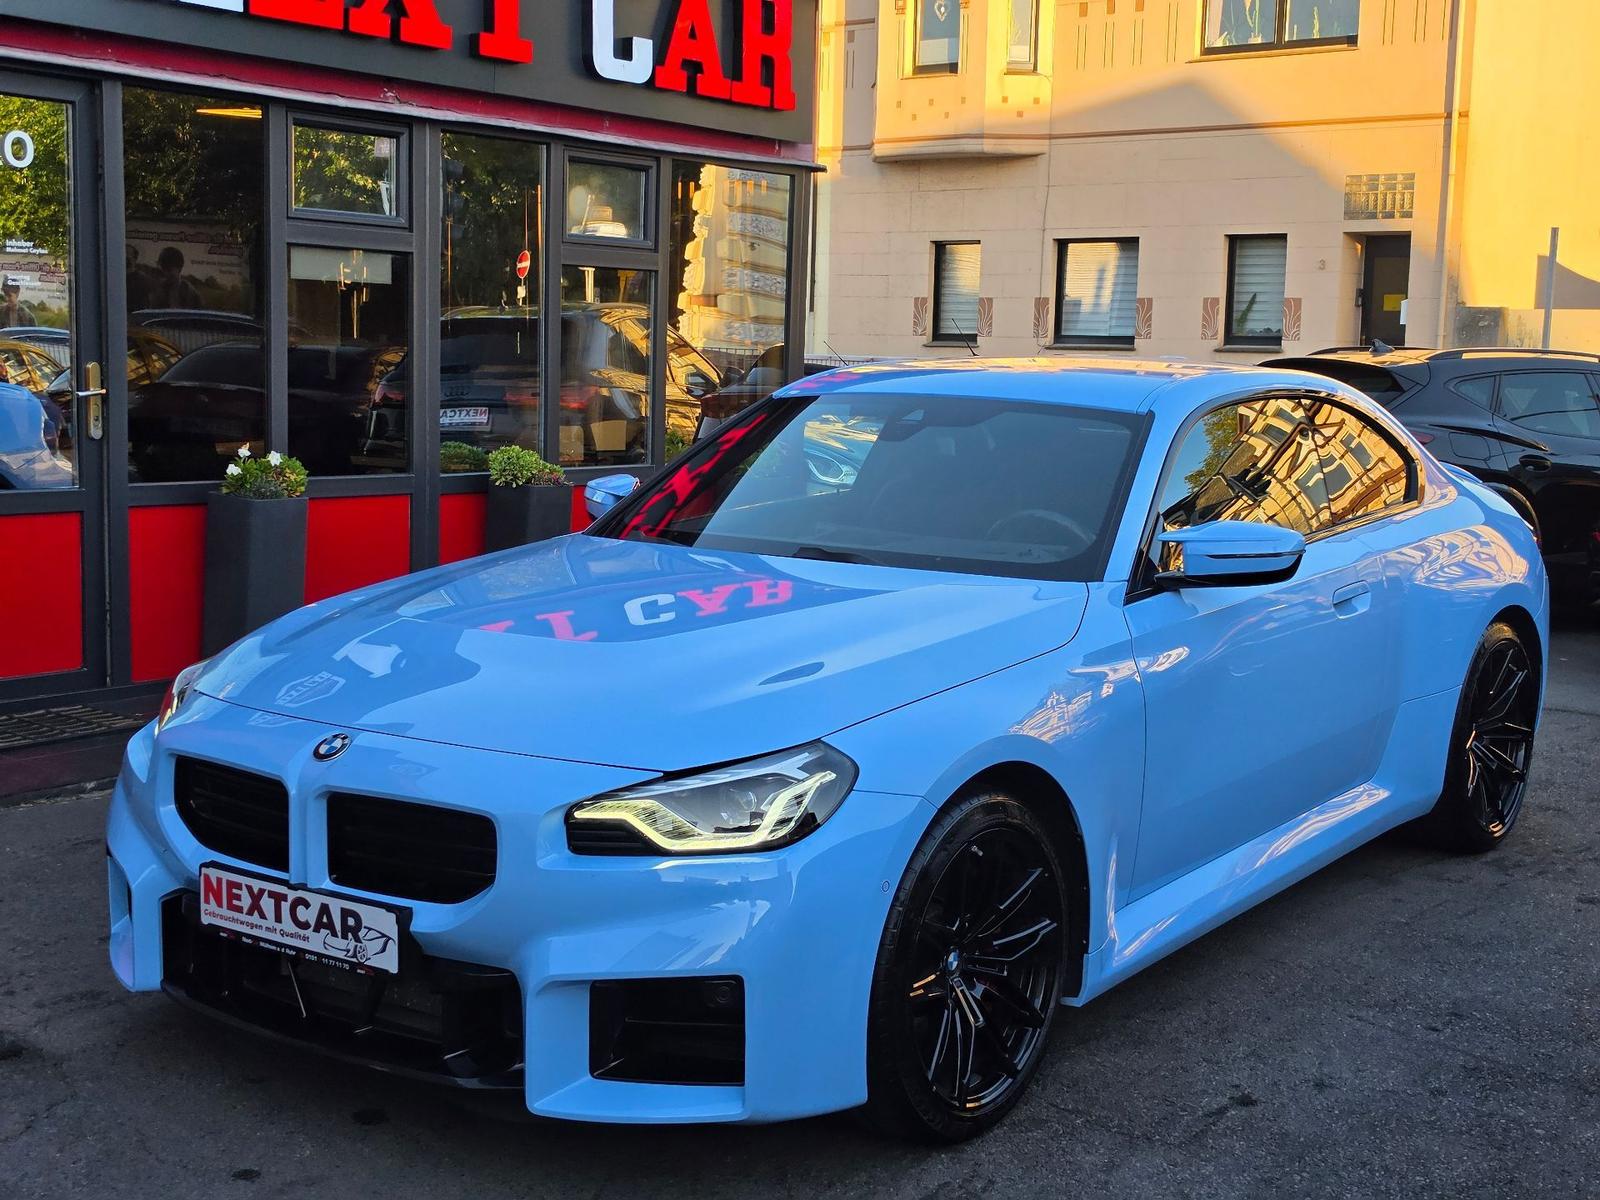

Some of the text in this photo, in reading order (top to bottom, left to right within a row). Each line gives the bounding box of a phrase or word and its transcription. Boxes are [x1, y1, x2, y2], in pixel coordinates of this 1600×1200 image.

[0, 130, 34, 168] O
[6, 239, 34, 247] Inhaber
[1319, 259, 1326, 270] 3
[202, 873, 364, 943] NEXTCAR
[203, 909, 310, 942] Gebrauchtwagen mit Qualität
